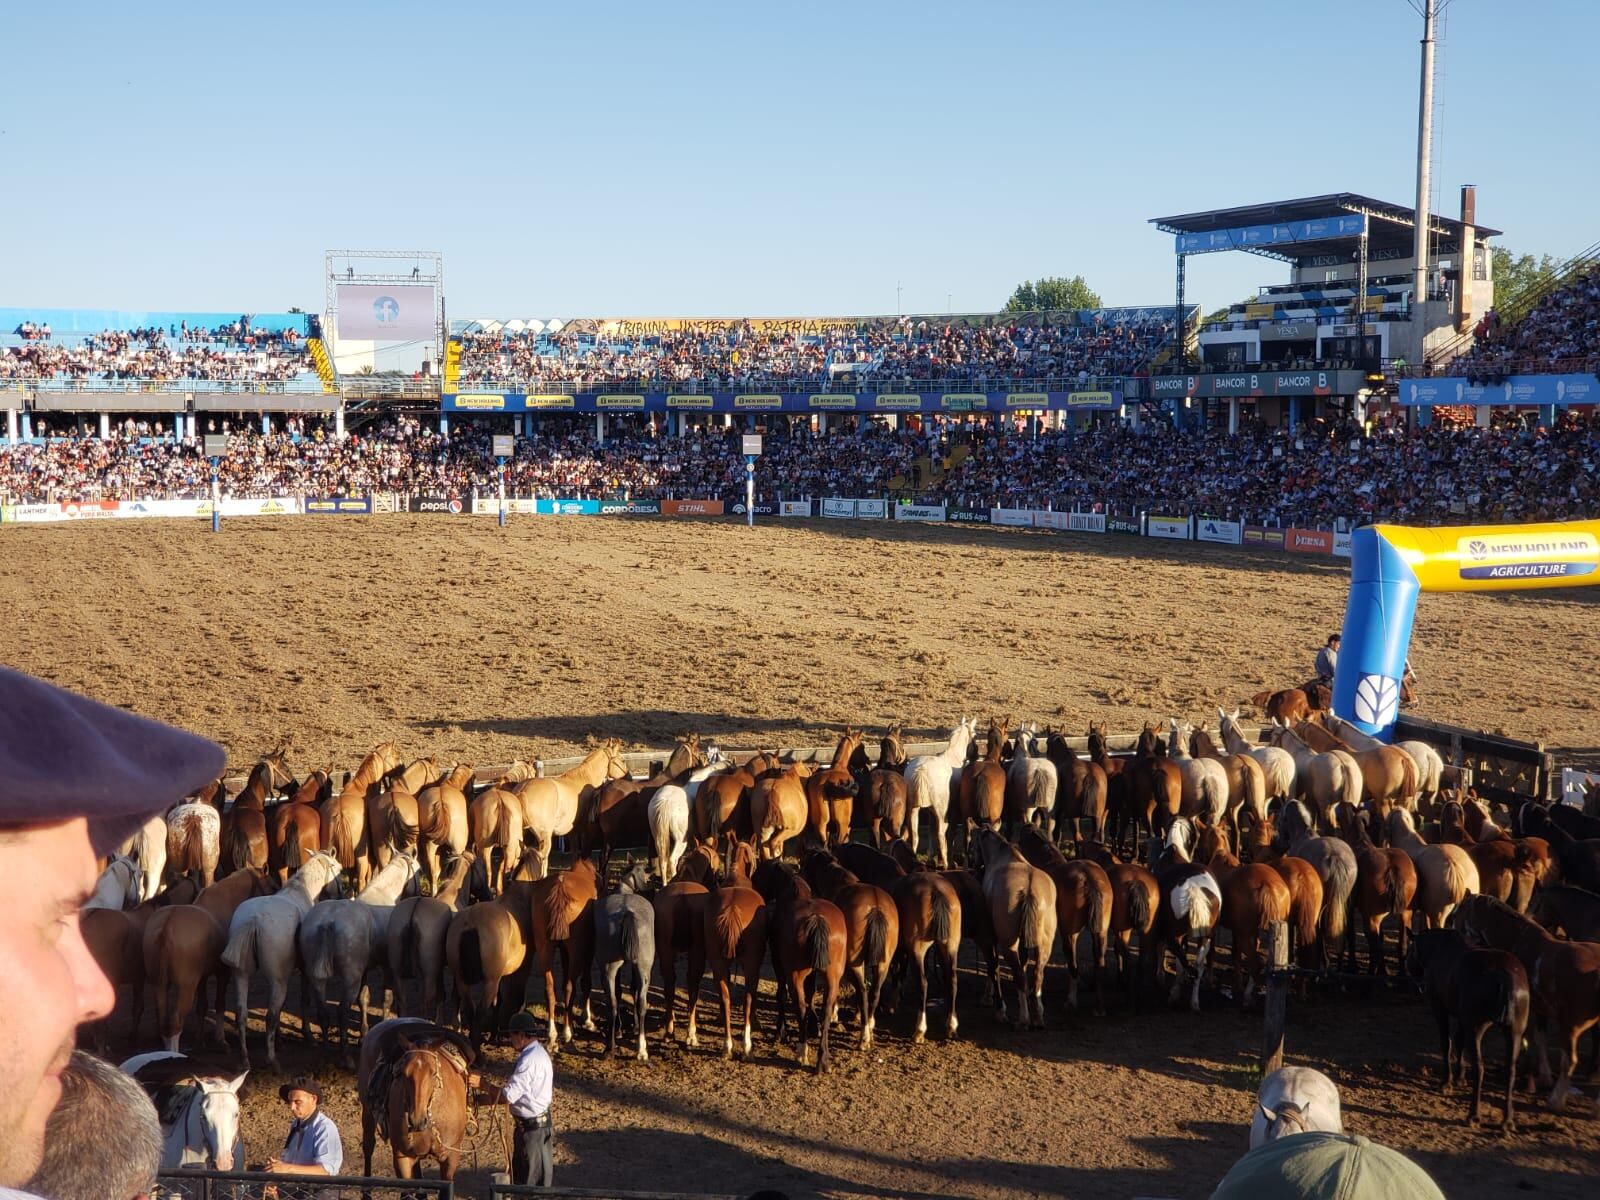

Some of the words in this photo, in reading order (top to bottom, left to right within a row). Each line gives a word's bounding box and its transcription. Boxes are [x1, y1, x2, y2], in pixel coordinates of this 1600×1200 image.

[1312, 255, 1338, 266] YESCA
[762, 319, 819, 336] PATRIA
[1277, 326, 1300, 335] YESCA
[1155, 379, 1183, 390] BANCOR
[1216, 377, 1246, 388] BANCOR
[1278, 376, 1311, 387] BANCOR
[420, 501, 448, 512] pepsi
[602, 505, 658, 513] CORDOBESA
[959, 511, 972, 520] RUS
[974, 513, 988, 521] Agro
[1116, 521, 1127, 529] RUS
[1491, 543, 1522, 556] NEW
[1526, 541, 1589, 555] HOLLAND
[1490, 564, 1566, 577] AGRICULTURE
